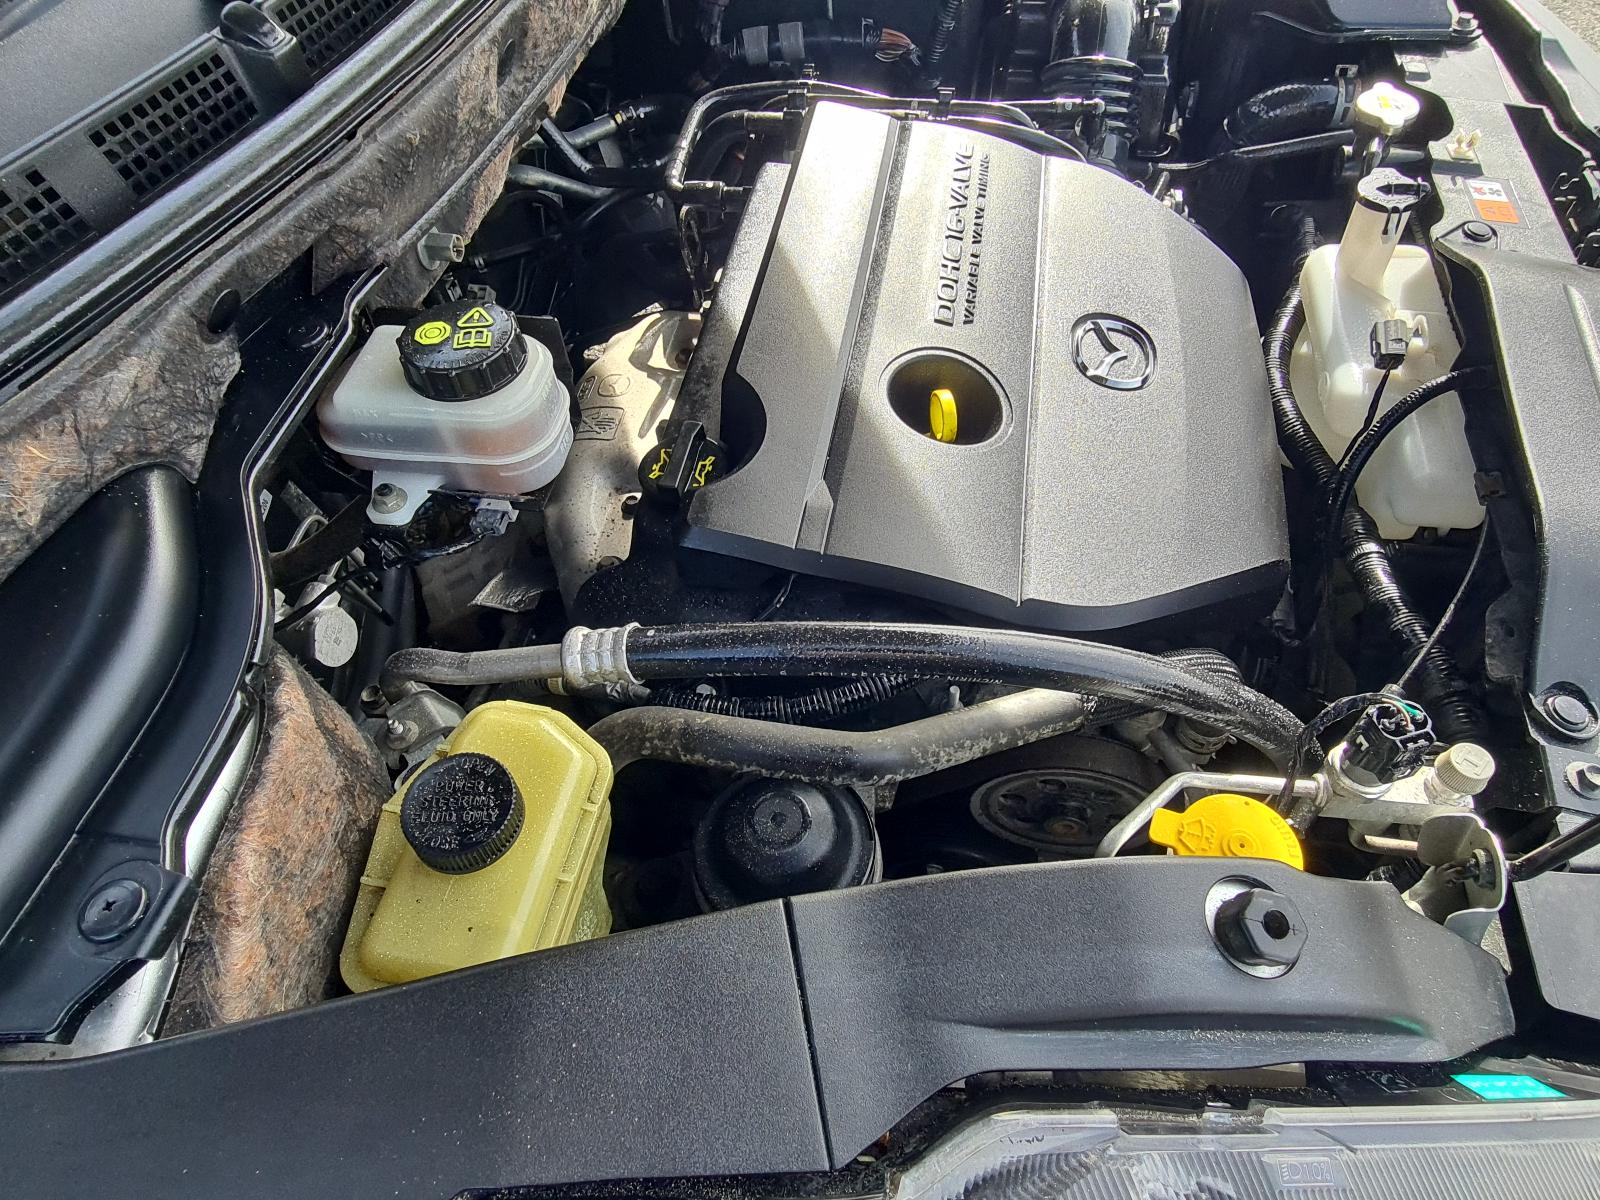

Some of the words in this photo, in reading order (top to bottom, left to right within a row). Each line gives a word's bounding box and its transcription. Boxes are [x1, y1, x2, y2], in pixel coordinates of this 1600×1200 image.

[976, 153, 991, 200] TIMING
[971, 201, 985, 244] VALVE
[934, 241, 962, 327] DOHC
[962, 247, 981, 325] VARIABLE
[420, 794, 498, 809] STEERING
[435, 780, 485, 793] POWER
[411, 810, 457, 823] FLUID
[463, 809, 499, 822] ONLY
